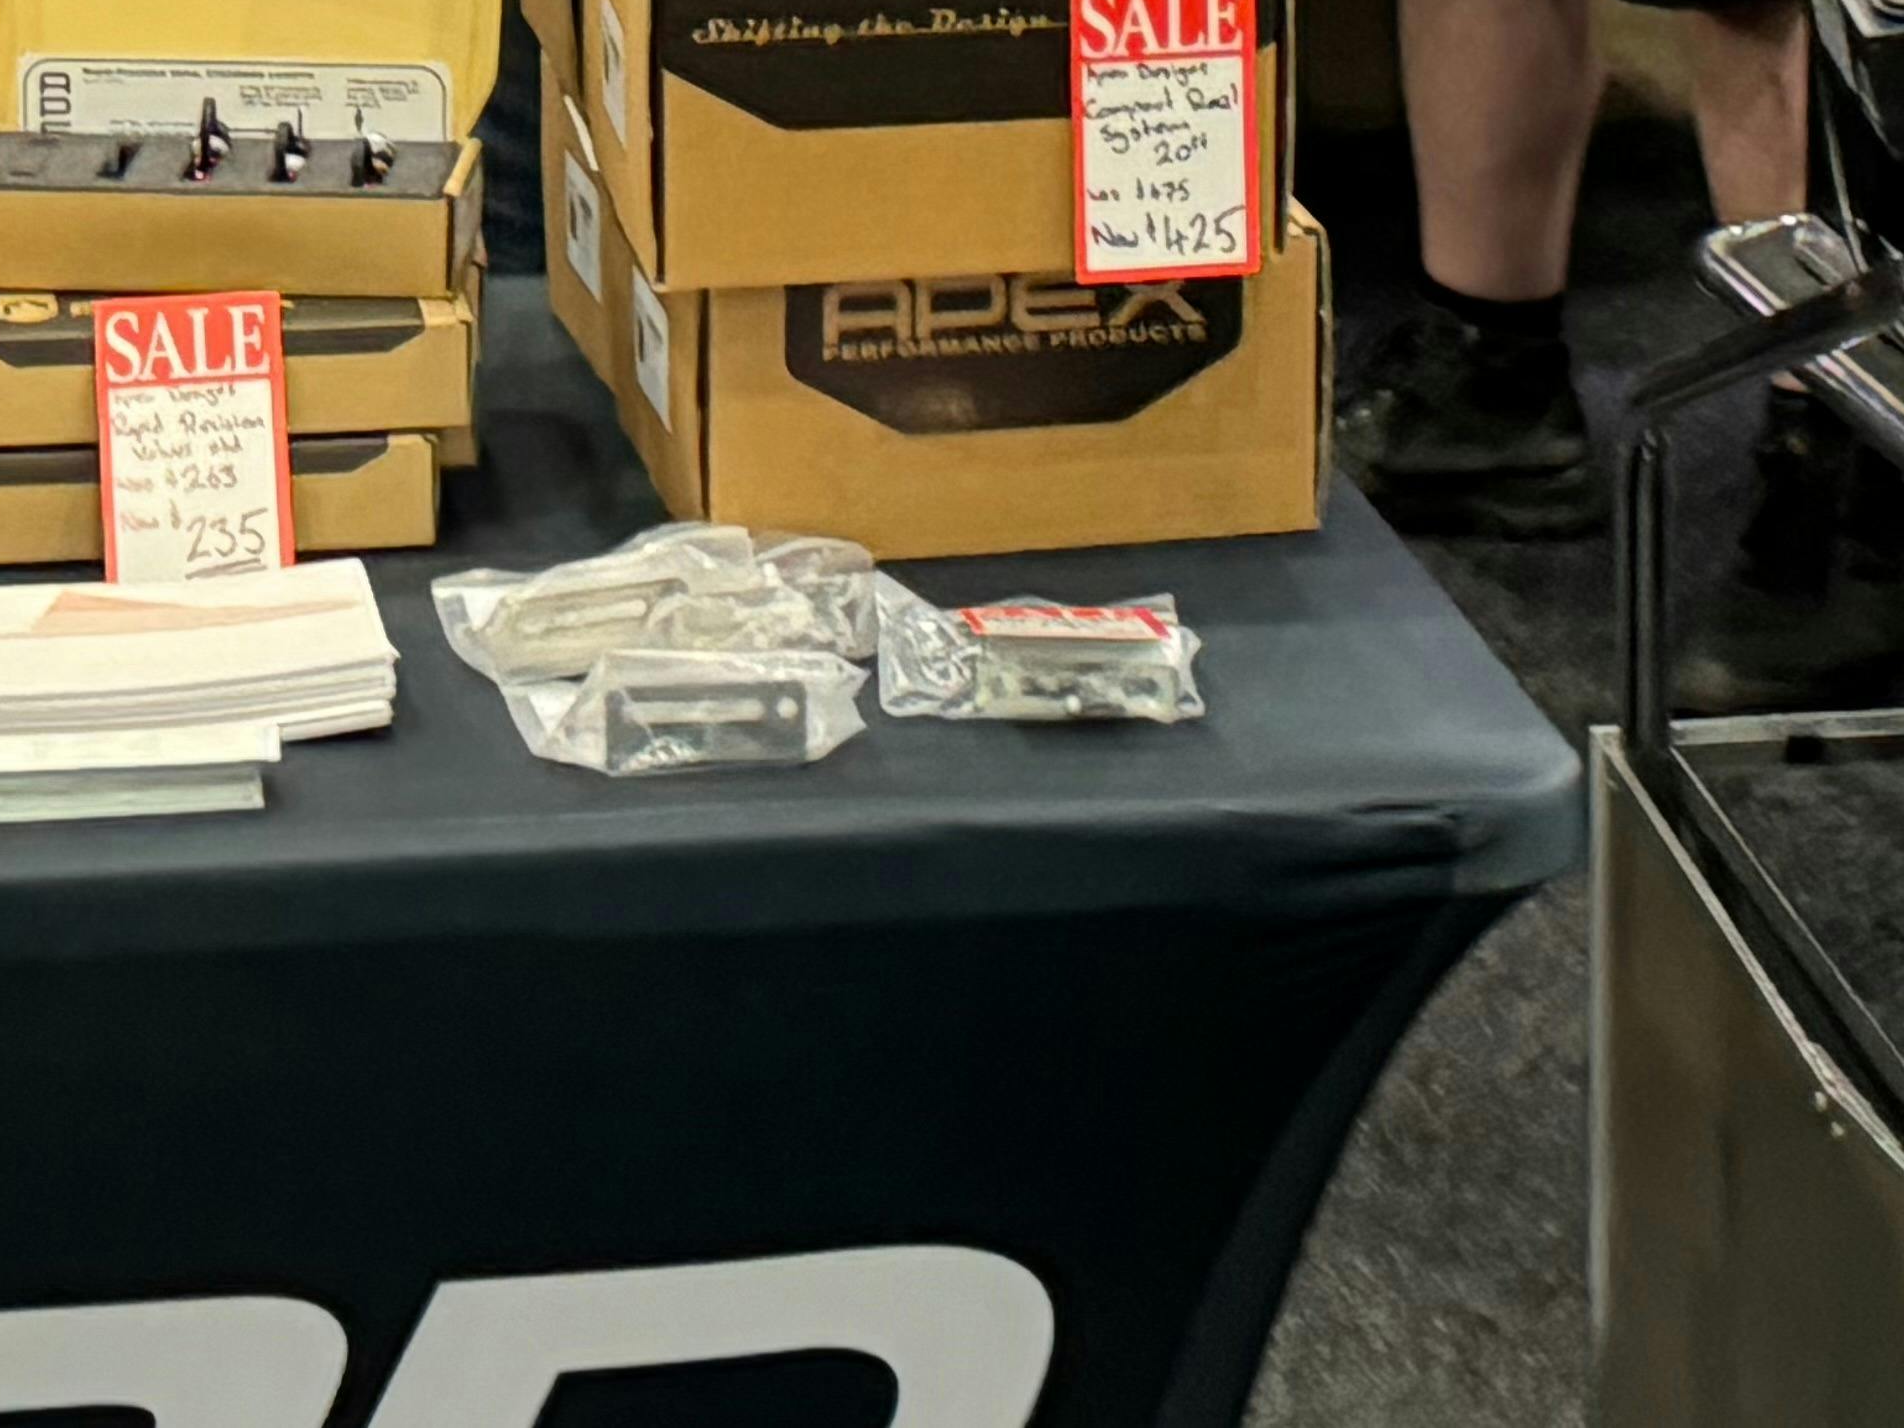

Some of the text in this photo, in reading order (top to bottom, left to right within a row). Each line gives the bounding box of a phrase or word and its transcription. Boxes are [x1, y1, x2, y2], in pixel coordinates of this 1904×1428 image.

[104, 303, 271, 384] SALE
[821, 276, 1210, 347] APEX
[822, 322, 1208, 363] PERFORMANCE PRODUCTS
